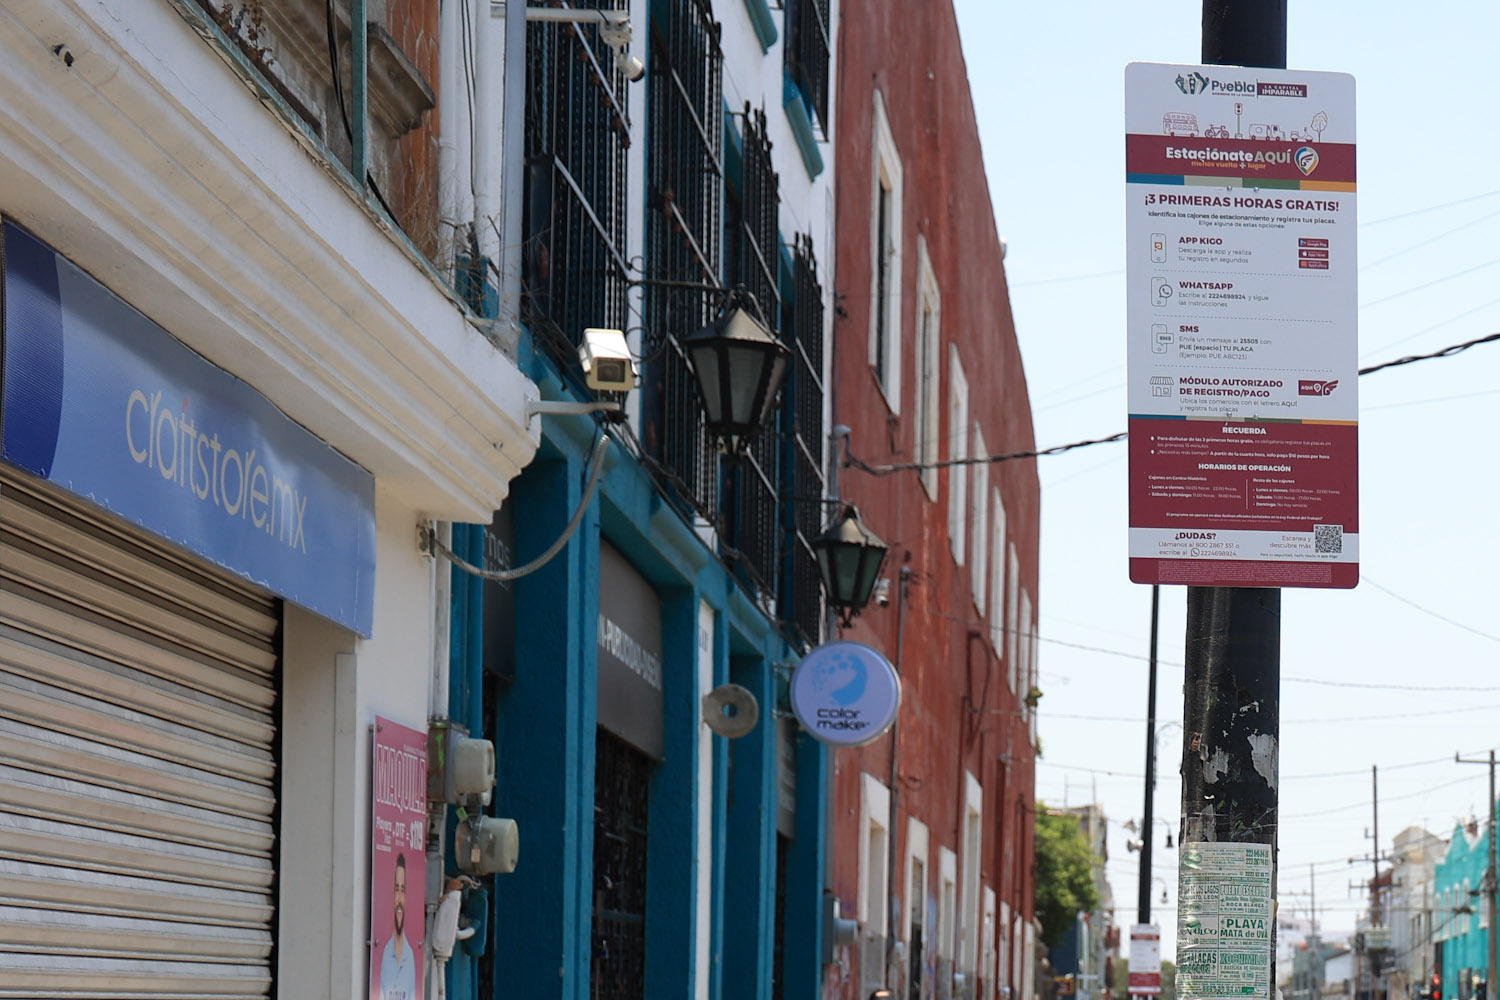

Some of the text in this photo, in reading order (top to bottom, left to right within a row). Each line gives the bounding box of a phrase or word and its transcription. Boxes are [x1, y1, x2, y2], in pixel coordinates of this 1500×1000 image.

[1211, 80, 1255, 93] Puebla
[1262, 89, 1303, 97] IMPARABLE
[1145, 194, 1339, 211] ¡3 PRIMERAS HORAS GRATIS!
[1187, 212, 1210, 220] cajones
[1179, 281, 1233, 290] WHATSAPP
[1179, 325, 1199, 333] SMS
[1179, 376, 1283, 388] MÓDULO AUTORIZADO
[1194, 388, 1270, 398] REGISTRO/PAGO
[1222, 426, 1267, 435] RECUERDA
[1248, 464, 1291, 472] OPERACIÓN
[1175, 532, 1217, 540] ¿DUDAS?
[817, 708, 860, 719] color
[376, 743, 426, 816] MAQUILA
[1226, 919, 1264, 929] PLAYA
[1220, 929, 1243, 938] MATA
[1245, 930, 1255, 938] de
